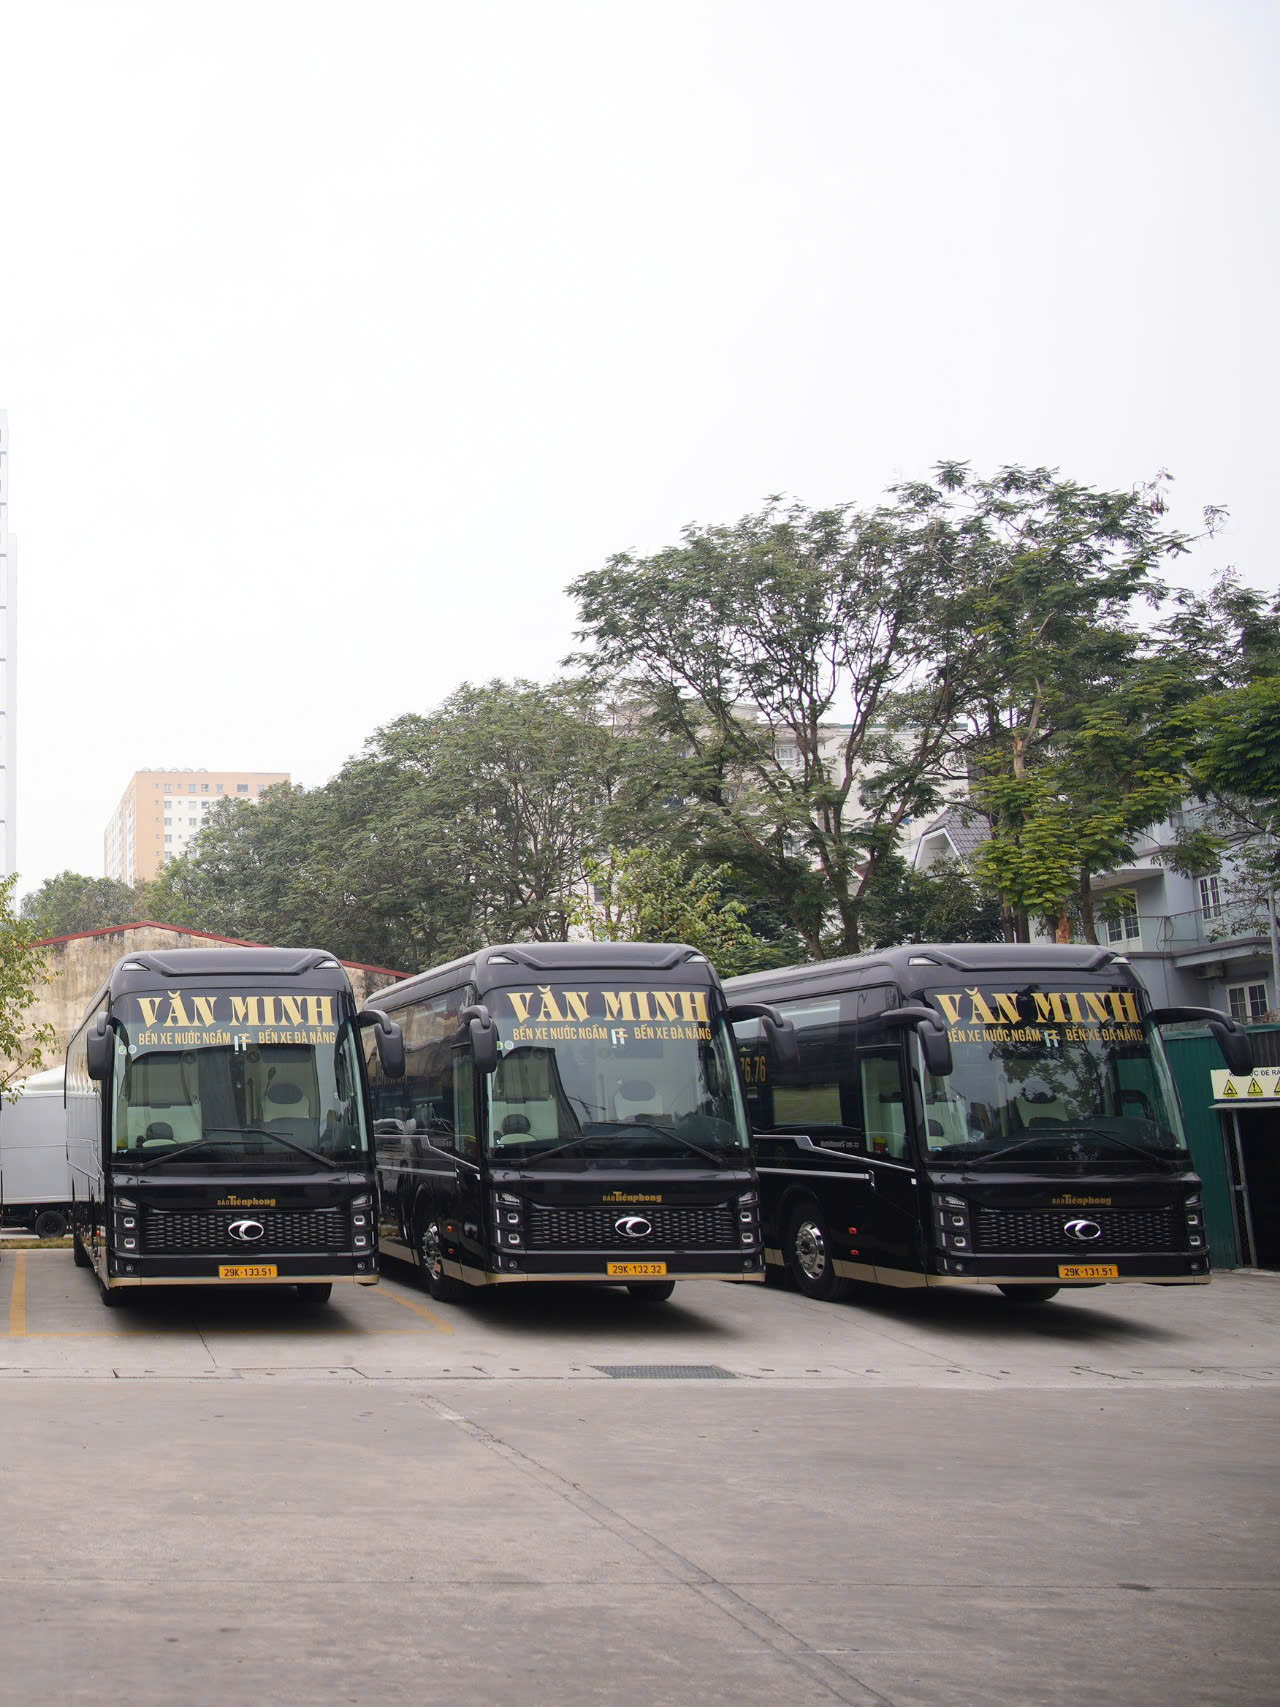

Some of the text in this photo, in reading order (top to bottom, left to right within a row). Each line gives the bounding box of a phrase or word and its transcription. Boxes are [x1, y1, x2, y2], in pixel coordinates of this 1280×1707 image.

[136, 990, 335, 1028] VĂN MINH
[506, 985, 710, 1023] VĂN MINH
[934, 987, 1141, 1025] VĂN MINH
[258, 1028, 277, 1044] BẾN
[279, 1032, 294, 1044] XE
[296, 1029, 308, 1044] ĐÀ
[535, 1028, 549, 1040] XE
[634, 1024, 654, 1039] BẾN
[656, 1028, 669, 1039] XE
[671, 1024, 684, 1039] ĐÀ
[968, 1030, 981, 1042] XE
[1088, 1029, 1101, 1040] XE
[160, 1032, 173, 1044] XE
[224, 1268, 272, 1277] 29K-133.51
[612, 1265, 662, 1273] 29K-132.32
[1064, 1267, 1113, 1276] 29K-131.51
